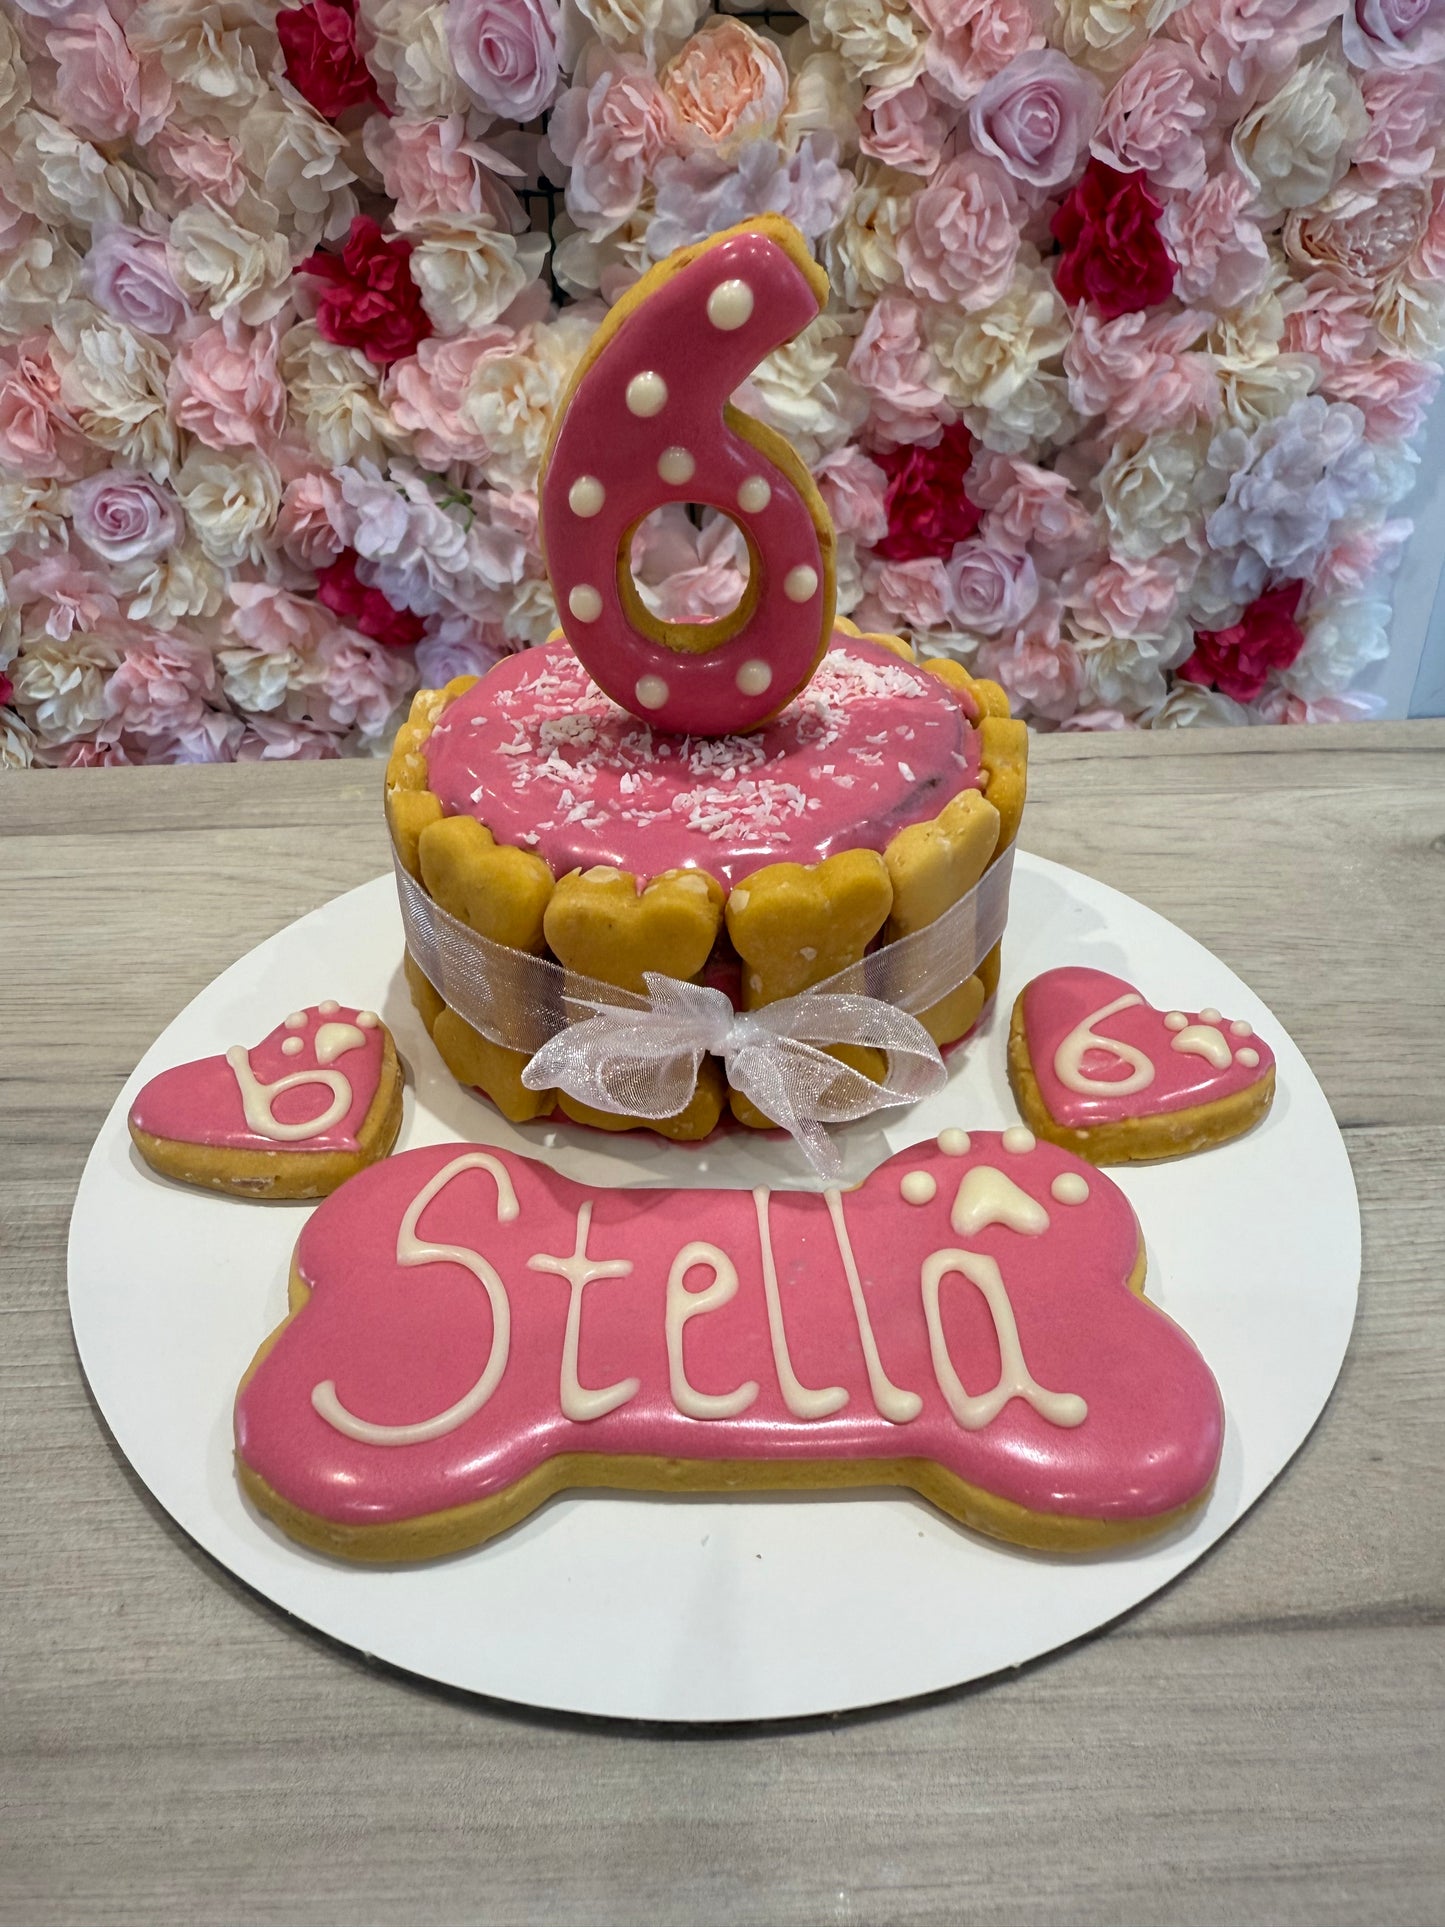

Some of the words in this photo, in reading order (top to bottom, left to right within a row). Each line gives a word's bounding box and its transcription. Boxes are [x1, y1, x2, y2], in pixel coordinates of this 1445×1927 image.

[538, 212, 837, 736] 6
[226, 1045, 353, 1142] 6
[1053, 992, 1156, 1097] 6
[310, 1152, 1089, 1446] Stella
